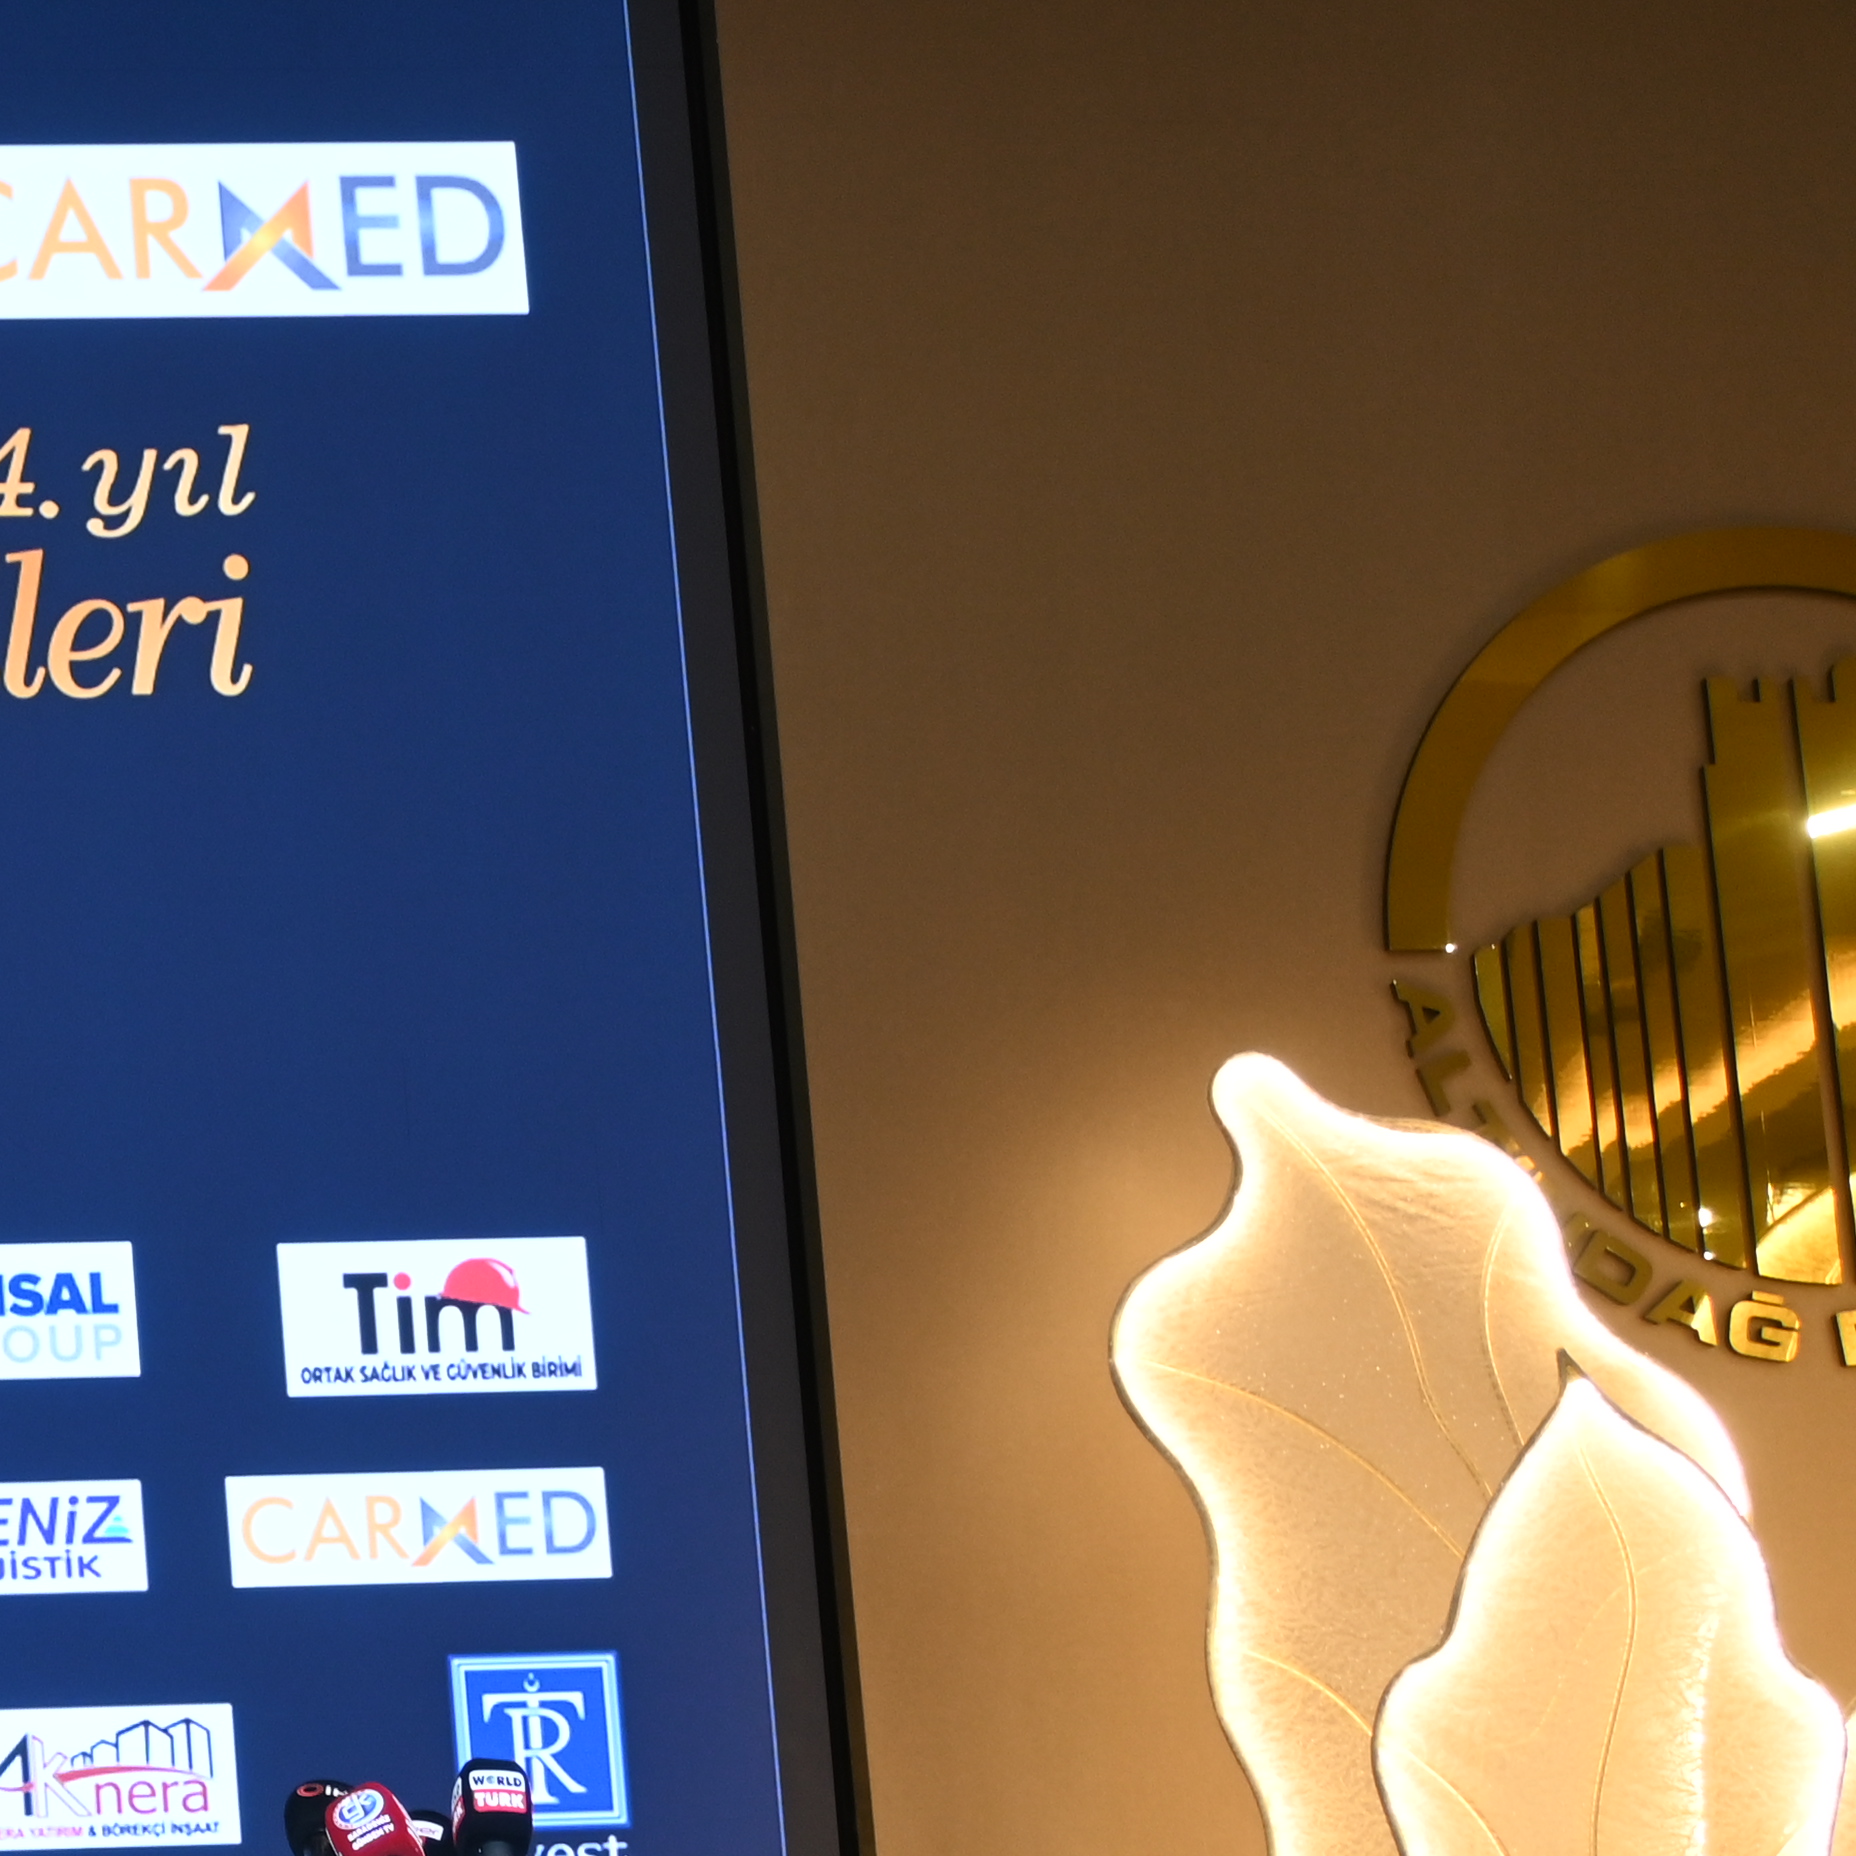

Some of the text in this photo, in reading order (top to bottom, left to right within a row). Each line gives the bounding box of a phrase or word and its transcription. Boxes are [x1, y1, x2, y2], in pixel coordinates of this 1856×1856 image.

[81, 423, 256, 539] yıl
[343, 1271, 516, 1355] Tim
[300, 1354, 583, 1385] ORTAK SAĞLIK VE GÜVENLİK BİRİMİ
[242, 1490, 597, 1567] CARMED
[88, 1825, 97, 1837] &
[102, 1822, 166, 1837] BÖREKÇİ
